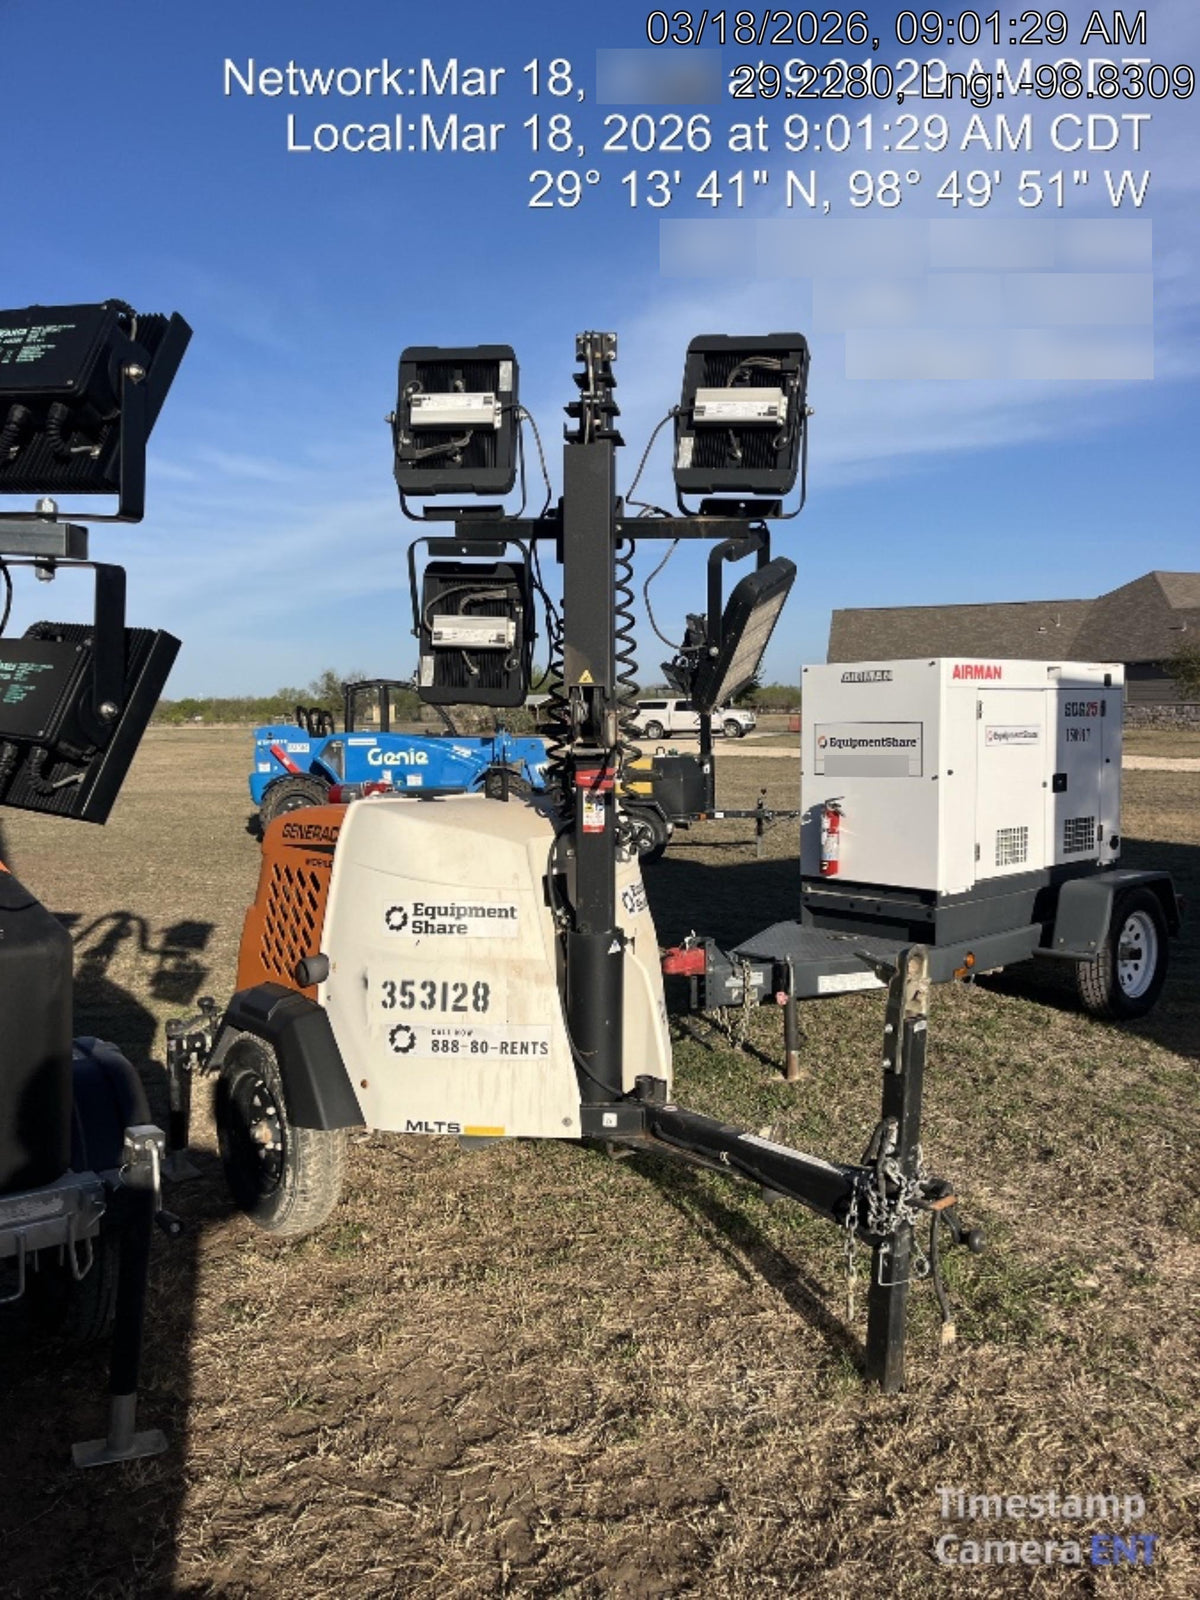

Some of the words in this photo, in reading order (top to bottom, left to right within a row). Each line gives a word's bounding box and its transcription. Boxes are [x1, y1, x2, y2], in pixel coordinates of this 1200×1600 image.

[952, 664, 1002, 680] AIRMAN
[829, 737, 917, 749] EquipmentShare
[367, 748, 429, 766] Genie
[412, 902, 517, 920] Equipment
[411, 920, 468, 934] Share
[381, 979, 491, 1014] 353128
[431, 1039, 549, 1056] 888-80-RENTS
[405, 1119, 461, 1134] MLTS
